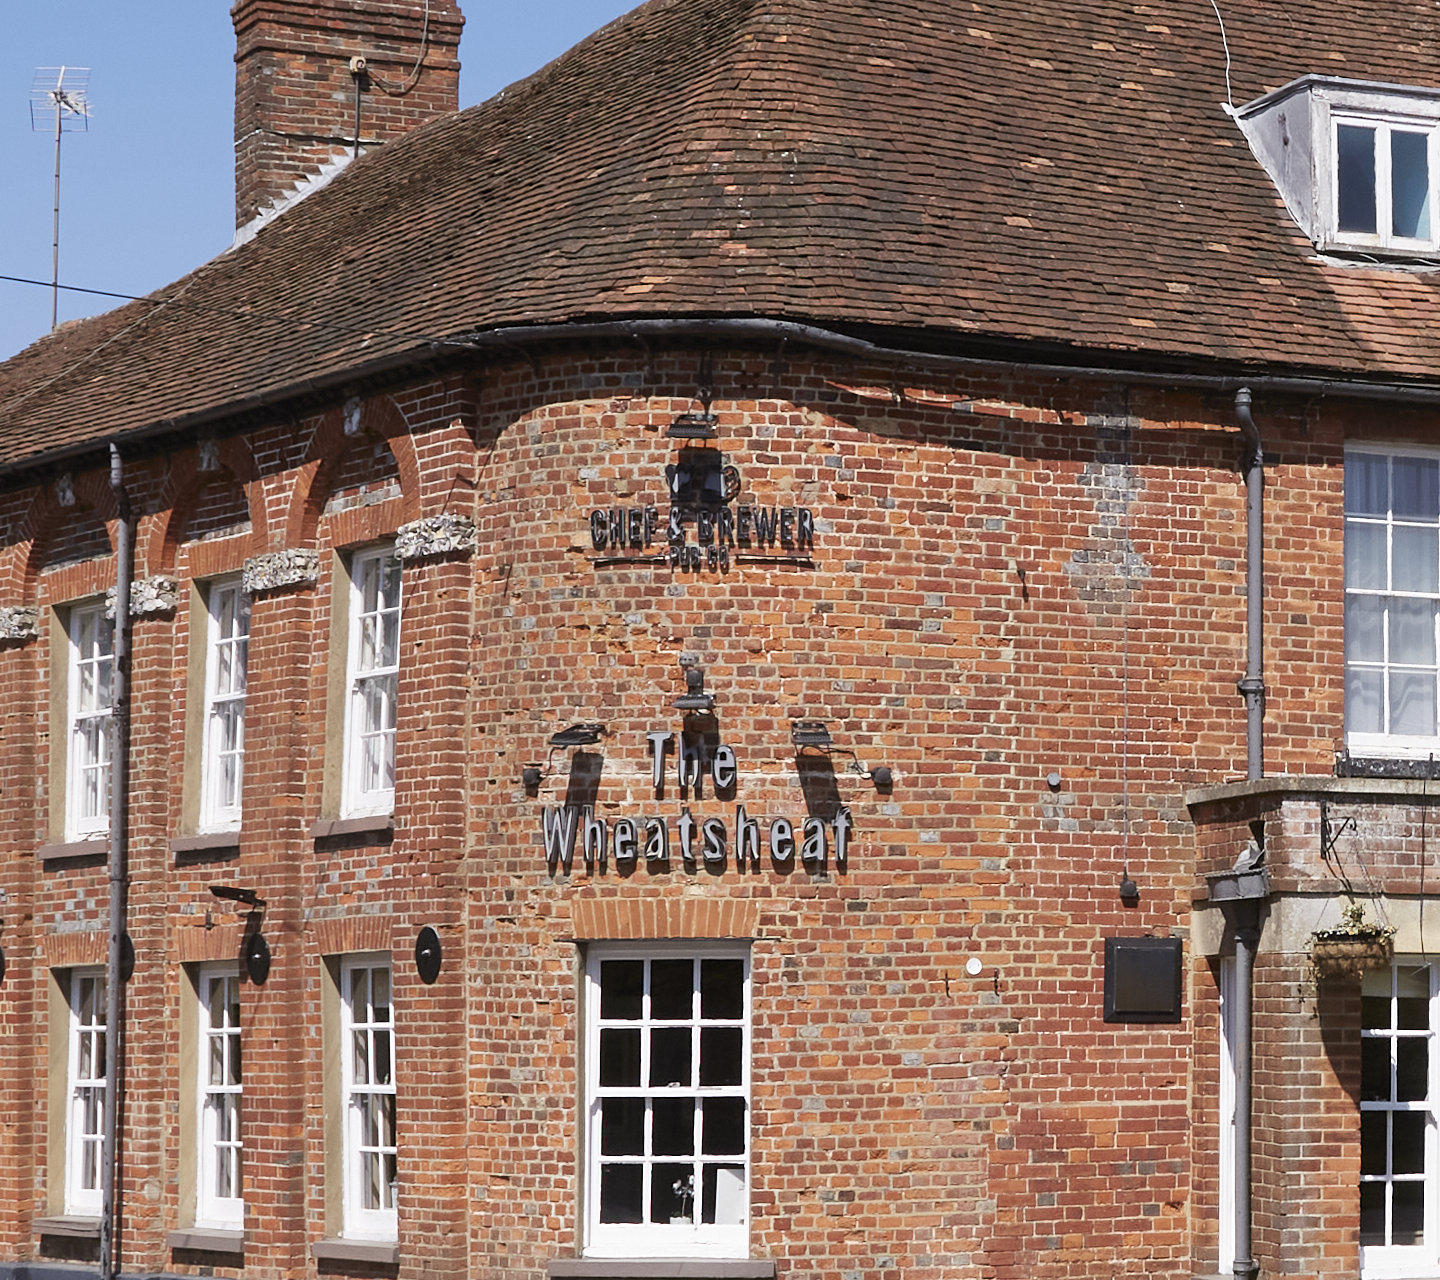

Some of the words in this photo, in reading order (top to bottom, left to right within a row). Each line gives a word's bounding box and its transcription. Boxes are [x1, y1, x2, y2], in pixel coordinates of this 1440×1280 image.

[590, 507, 658, 549] CHEF
[667, 506, 686, 542] &
[697, 507, 814, 549] BREWER
[669, 546, 701, 569] PUB
[646, 730, 737, 789] The
[542, 805, 851, 865] Wheatsheaf
